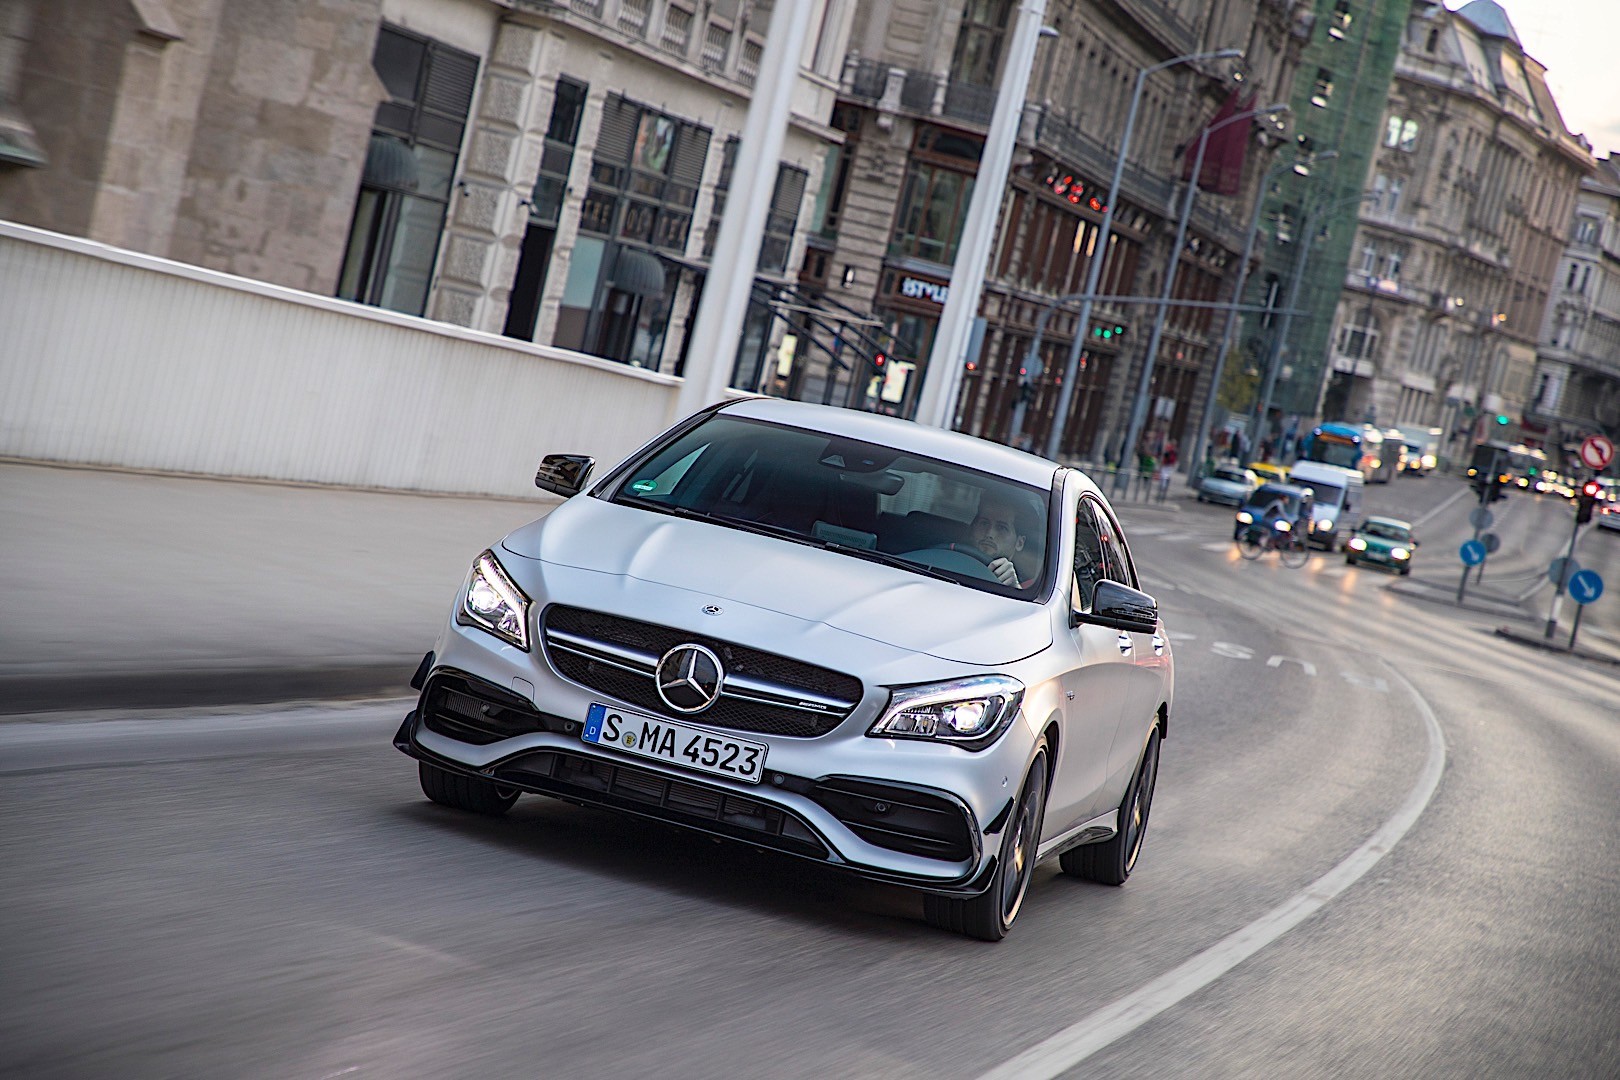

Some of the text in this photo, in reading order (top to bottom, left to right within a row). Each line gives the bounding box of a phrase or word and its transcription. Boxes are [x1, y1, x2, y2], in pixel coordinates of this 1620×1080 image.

[590, 727, 597, 735] D
[603, 714, 759, 775] S MA 4523
